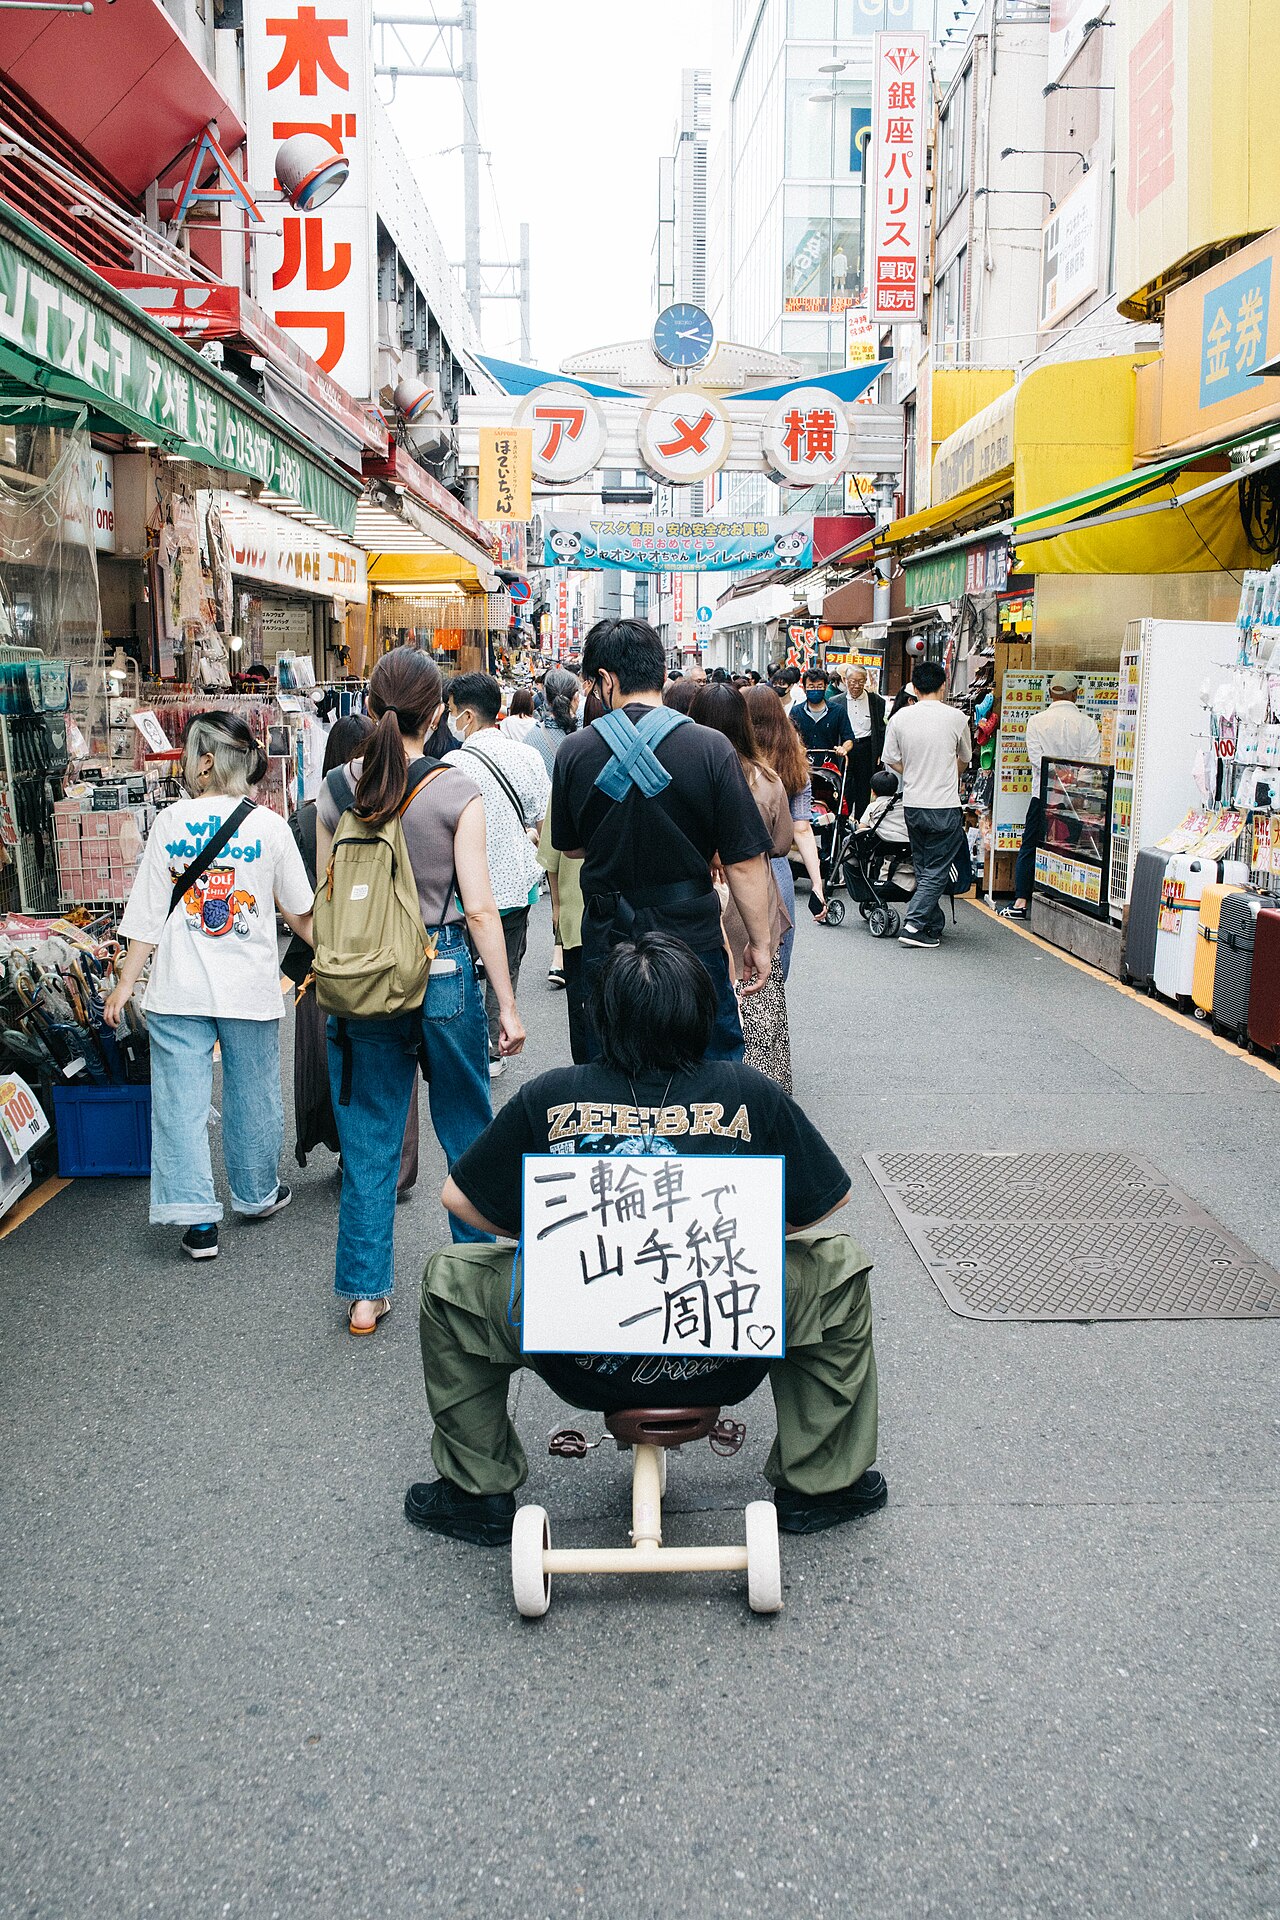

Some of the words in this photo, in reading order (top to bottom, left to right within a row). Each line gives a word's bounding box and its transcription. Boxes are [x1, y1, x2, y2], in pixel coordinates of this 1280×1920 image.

[882, 82, 917, 247] 銀座パリス
[879, 261, 915, 281] 買取
[878, 289, 915, 309] 販売
[1205, 286, 1263, 386] 金券
[533, 405, 837, 464] アメ横
[495, 440, 514, 514] ほていちゃん
[590, 520, 769, 537] マスク着用・安心安全なお買物
[631, 538, 716, 549] 命名おめでとう
[583, 547, 690, 562] シャオシャオちゃん
[695, 550, 774, 563] レイレイちゃん
[826, 654, 882, 666] 今月目玉商品
[5, 1091, 35, 1132] 100
[28, 1118, 41, 1135] 110
[546, 1101, 752, 1142] ZEEBRA
[533, 1159, 738, 1241] 三輪車で
[579, 1215, 758, 1286] 山手線
[618, 1279, 761, 1351] 一周中
